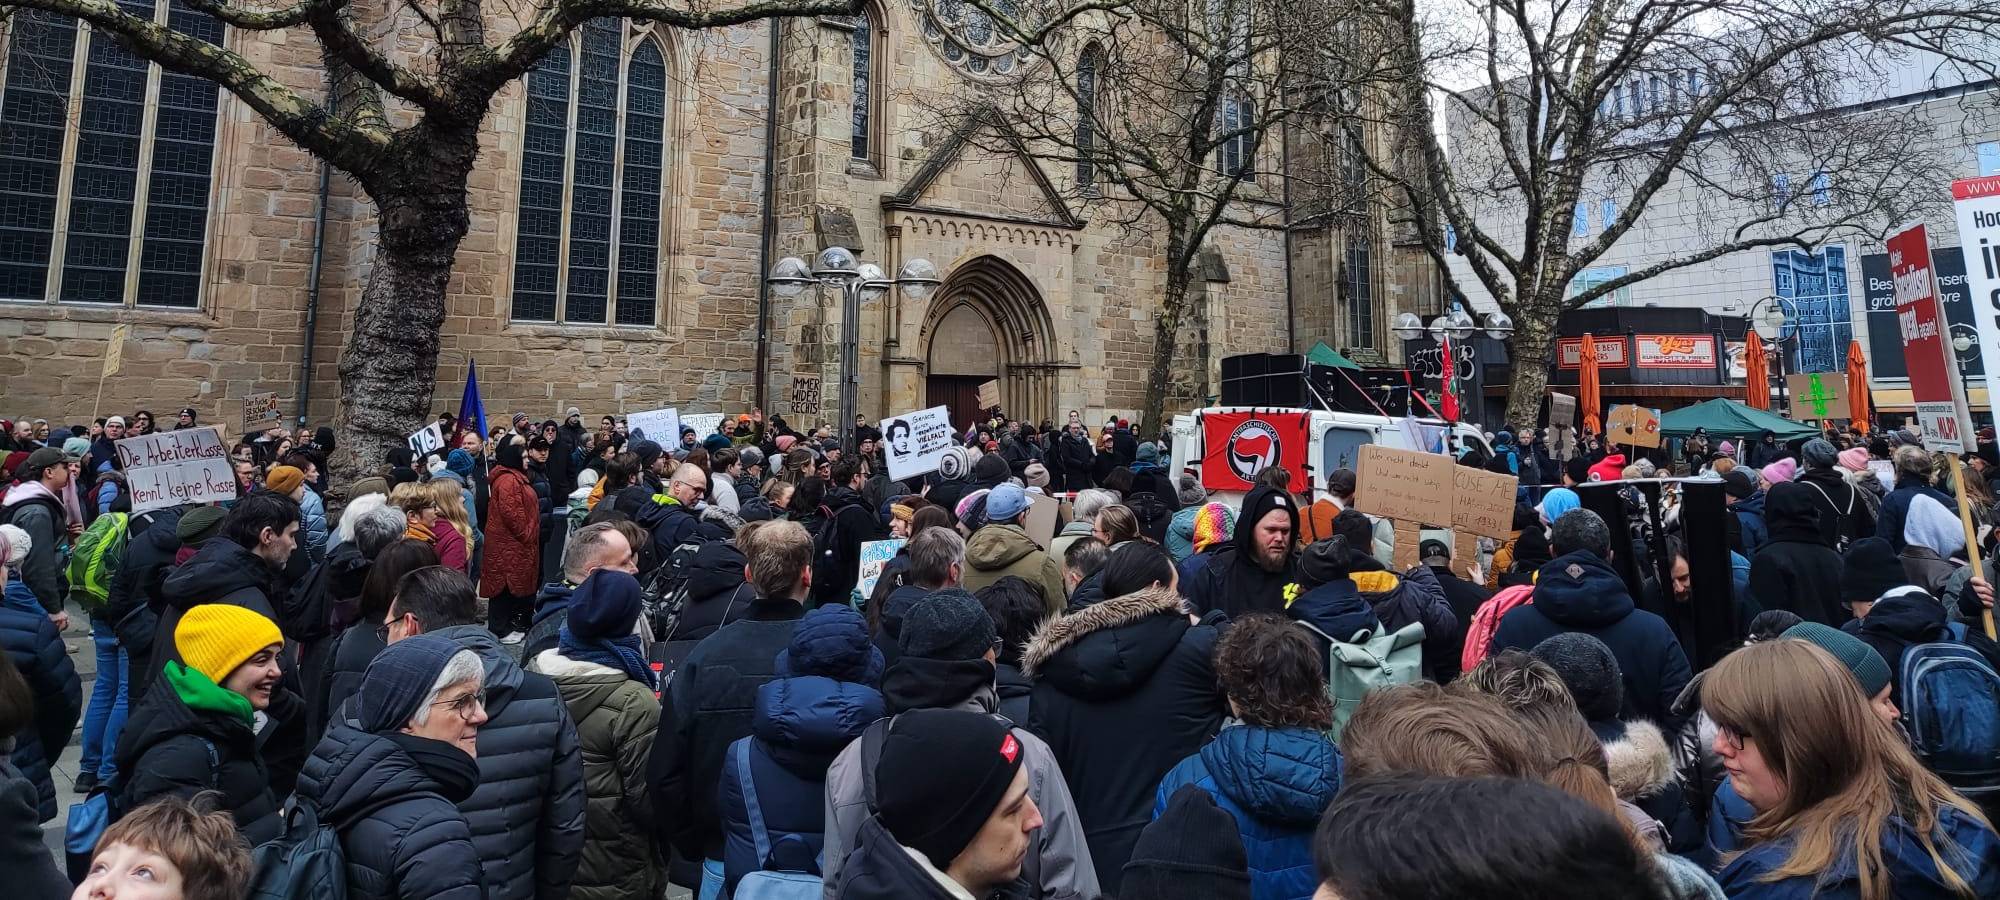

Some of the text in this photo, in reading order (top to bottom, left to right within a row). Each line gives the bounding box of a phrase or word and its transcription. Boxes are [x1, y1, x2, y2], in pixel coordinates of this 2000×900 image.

[1870, 274, 1969, 291] Bes nsere
[1893, 264, 1932, 306] Socialism
[1899, 305, 1920, 346] great
[1602, 343, 1618, 352] BEST
[793, 376, 820, 391] IMMER
[790, 401, 818, 415] RECHTS
[916, 430, 946, 444] VIELFALT
[118, 443, 143, 469] Die
[147, 434, 225, 467] Arbeiterklasse
[1369, 448, 1383, 461] Wer
[1386, 455, 1404, 465] nicht
[131, 468, 235, 505] kennt keine Rasse
[1455, 471, 1513, 501] CUSE ME
